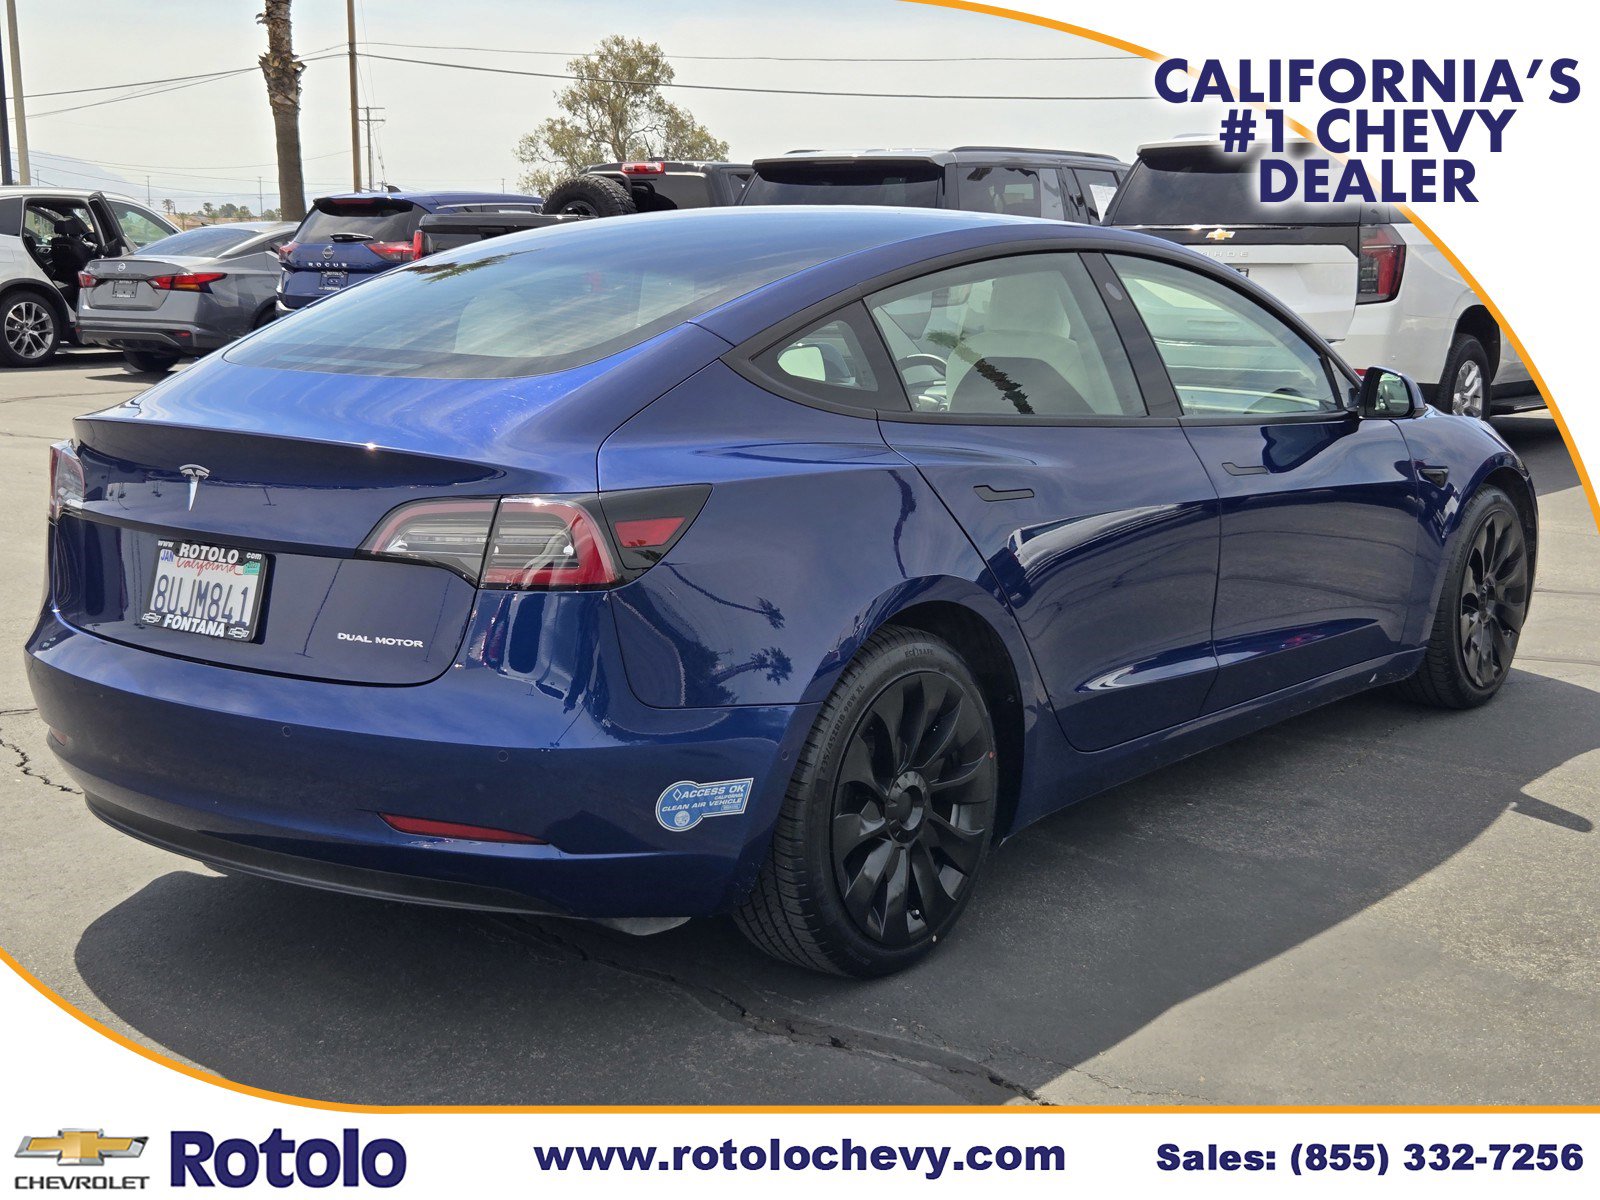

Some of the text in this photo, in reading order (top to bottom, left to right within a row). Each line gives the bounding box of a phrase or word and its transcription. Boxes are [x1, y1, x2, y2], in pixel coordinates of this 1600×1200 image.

[158, 540, 262, 565] www ROTOLO com
[160, 550, 174, 561] JAN
[153, 574, 249, 628] 8UJM841
[163, 613, 225, 637] FONTANA
[337, 632, 424, 648] DUAL MOTOR
[681, 785, 746, 799] ACCESS OK
[662, 804, 690, 812] CLEAN
[709, 798, 742, 806] VEHICLE
